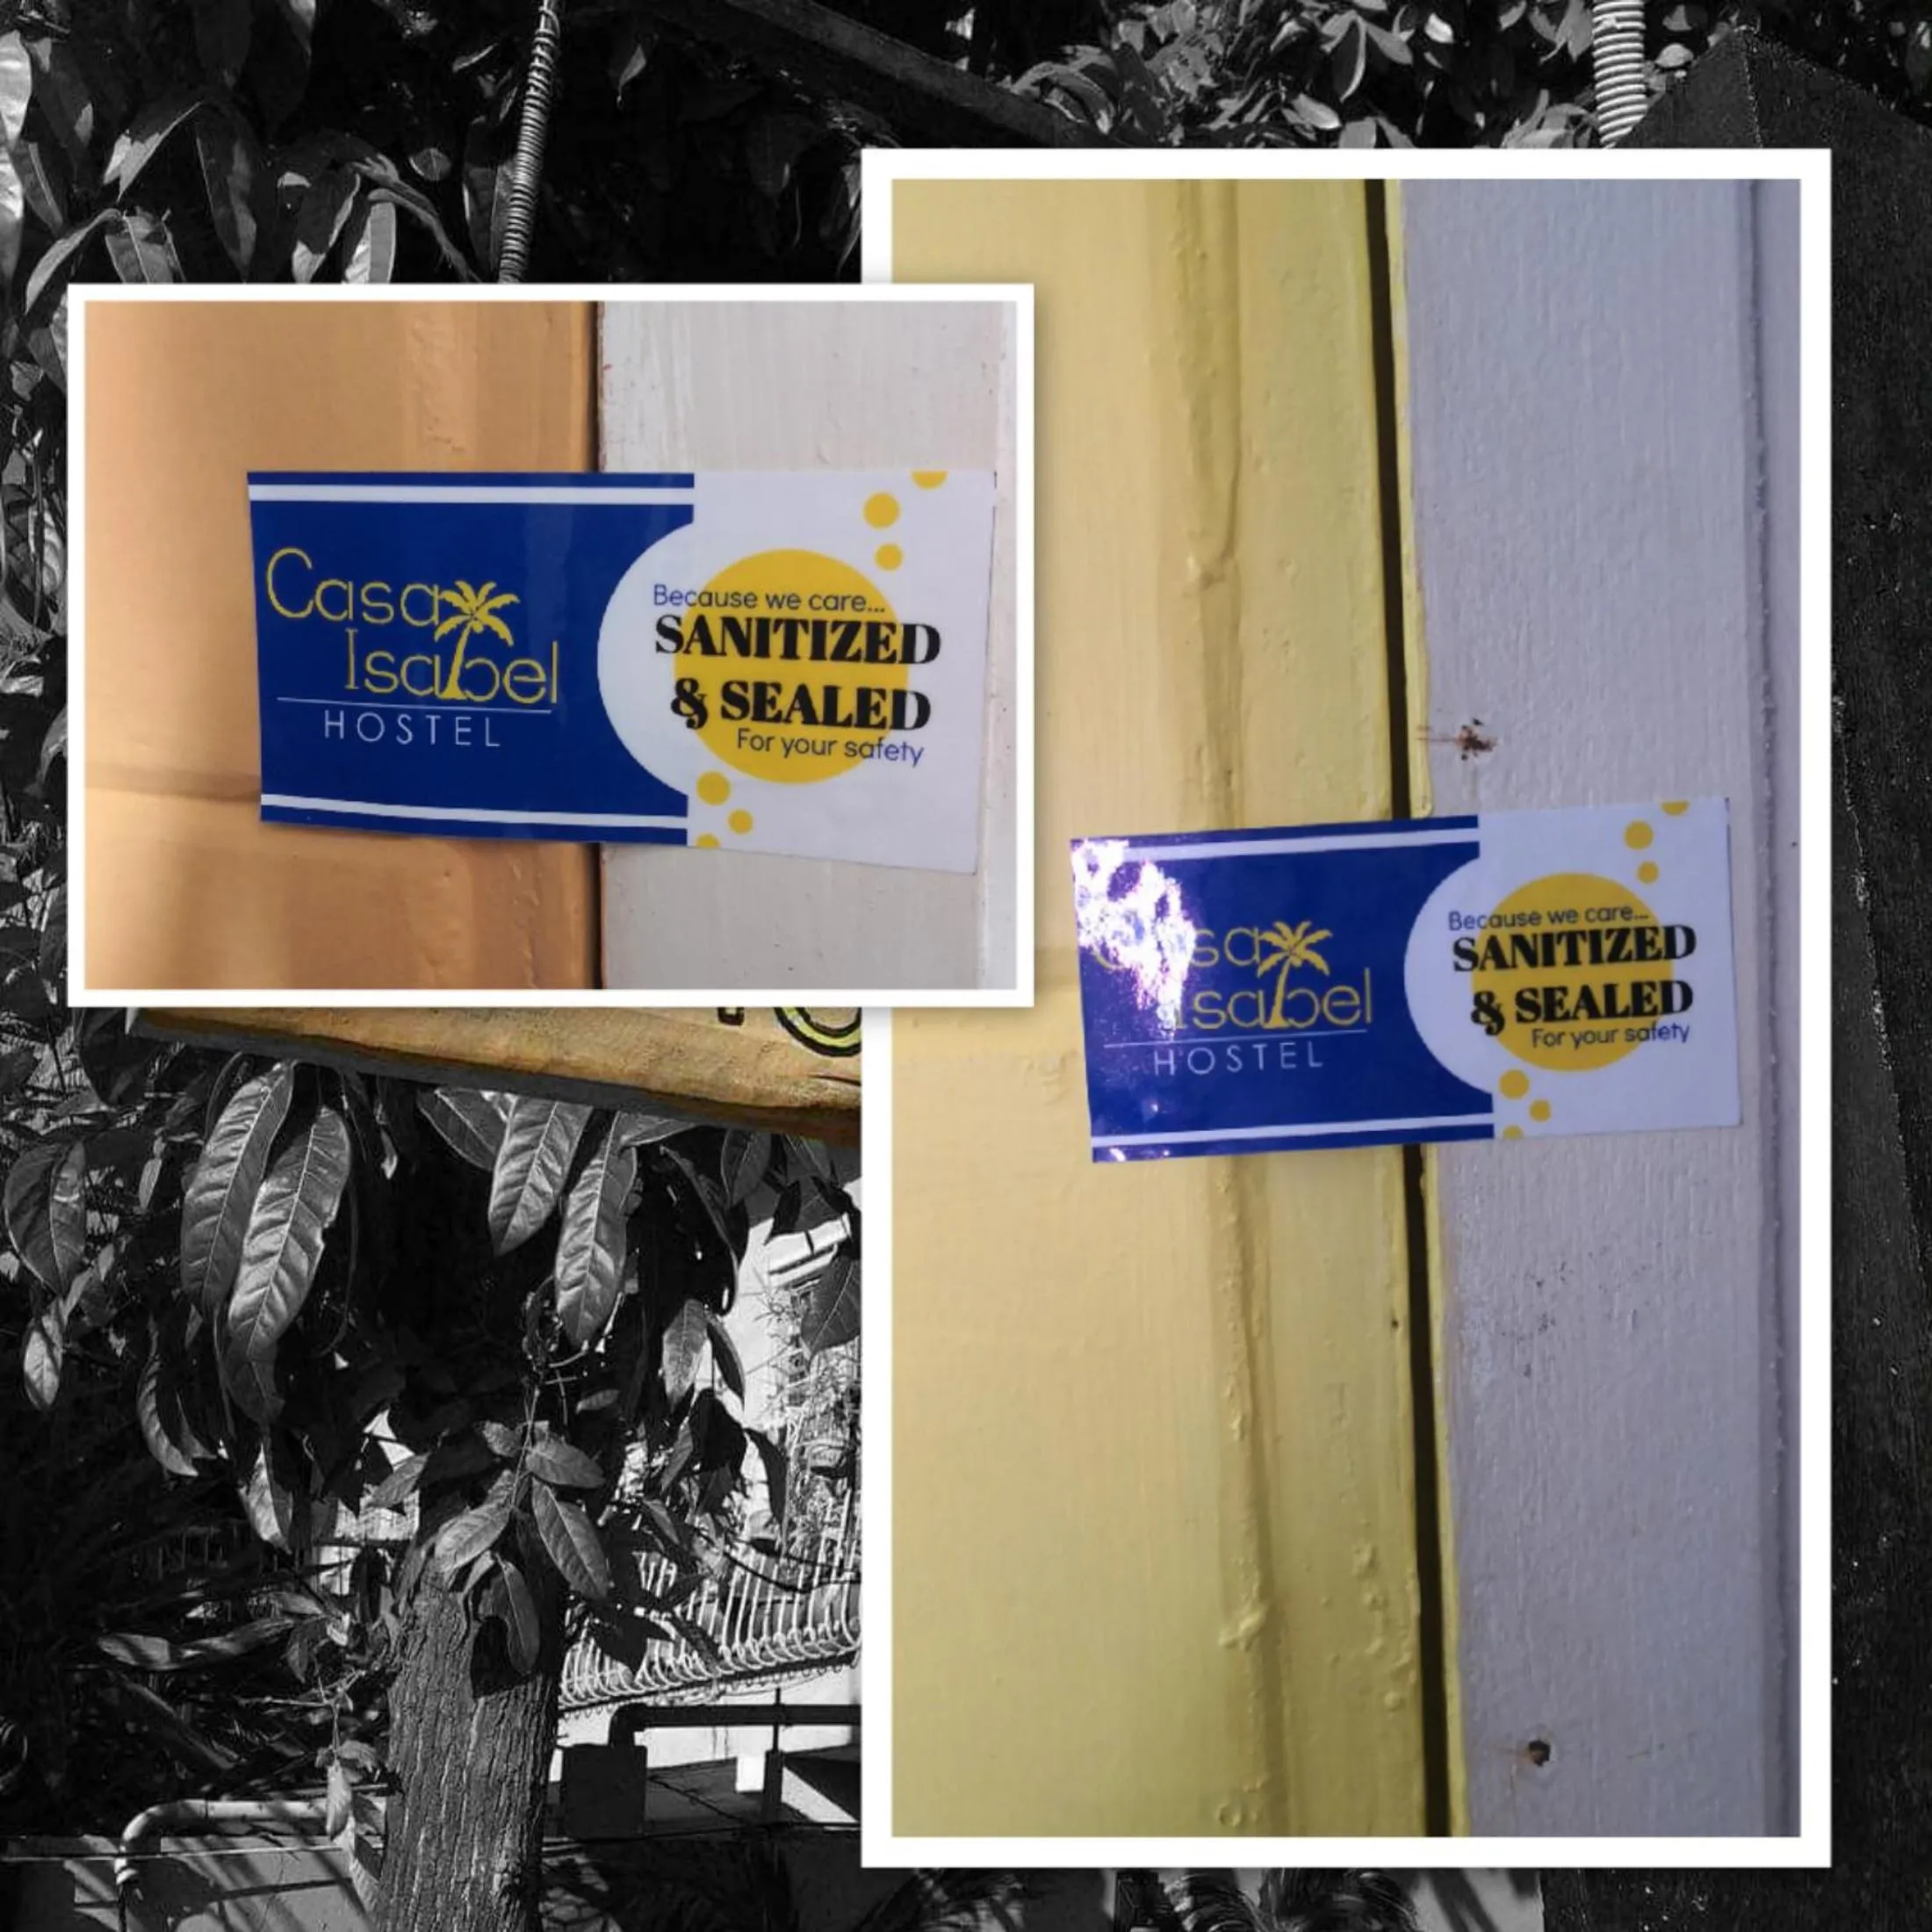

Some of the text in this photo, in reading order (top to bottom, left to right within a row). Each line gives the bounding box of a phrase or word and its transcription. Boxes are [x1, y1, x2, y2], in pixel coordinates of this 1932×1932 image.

[266, 546, 441, 626] Casa
[653, 584, 885, 614] Because we care...
[654, 614, 941, 665] SANITIZED
[345, 627, 558, 703] Isabel
[670, 677, 931, 731] & SEALED
[325, 709, 501, 746] HOSTEL
[737, 728, 925, 768] For your safety
[1448, 905, 1649, 931] Because we care...
[1453, 924, 1697, 973] SANITIZED
[1470, 979, 1694, 1036] & SEALED
[1532, 1021, 1690, 1050] For your safety
[1154, 1041, 1323, 1077] HOSTEL
